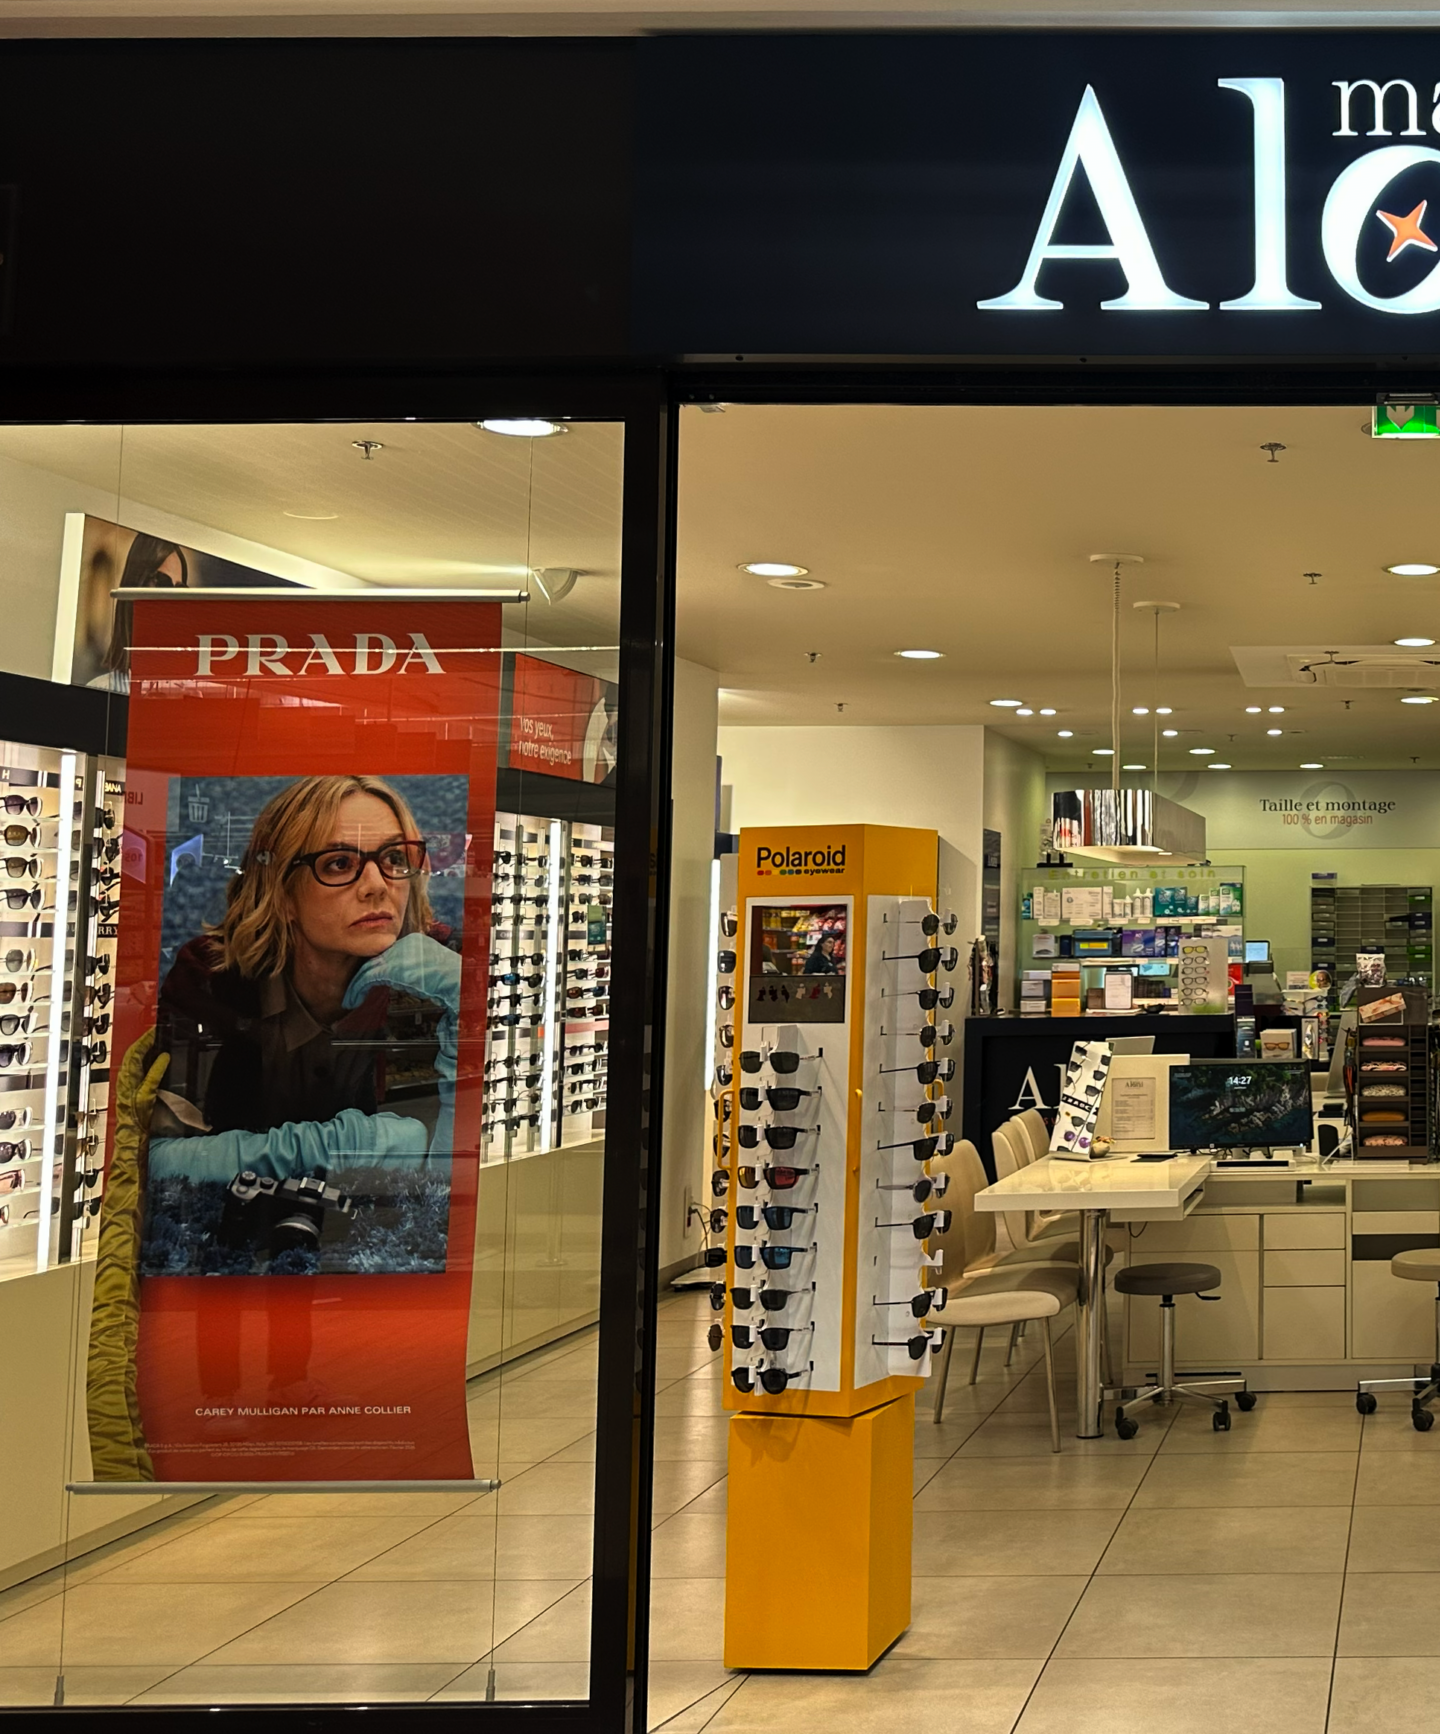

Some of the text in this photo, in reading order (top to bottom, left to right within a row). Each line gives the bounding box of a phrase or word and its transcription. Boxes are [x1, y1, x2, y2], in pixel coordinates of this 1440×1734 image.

[193, 633, 447, 676] PRADA
[1259, 799, 1396, 814] Taille et montage
[1282, 813, 1373, 828] 100 % en magasin
[756, 844, 846, 869] Polaroid
[803, 868, 845, 876] eyewear
[1050, 868, 1216, 880] Entretien et soin
[1228, 1076, 1253, 1085] 14:27
[195, 1406, 412, 1416] CAREY MULLIGAN PAR ANNE COLLIER
